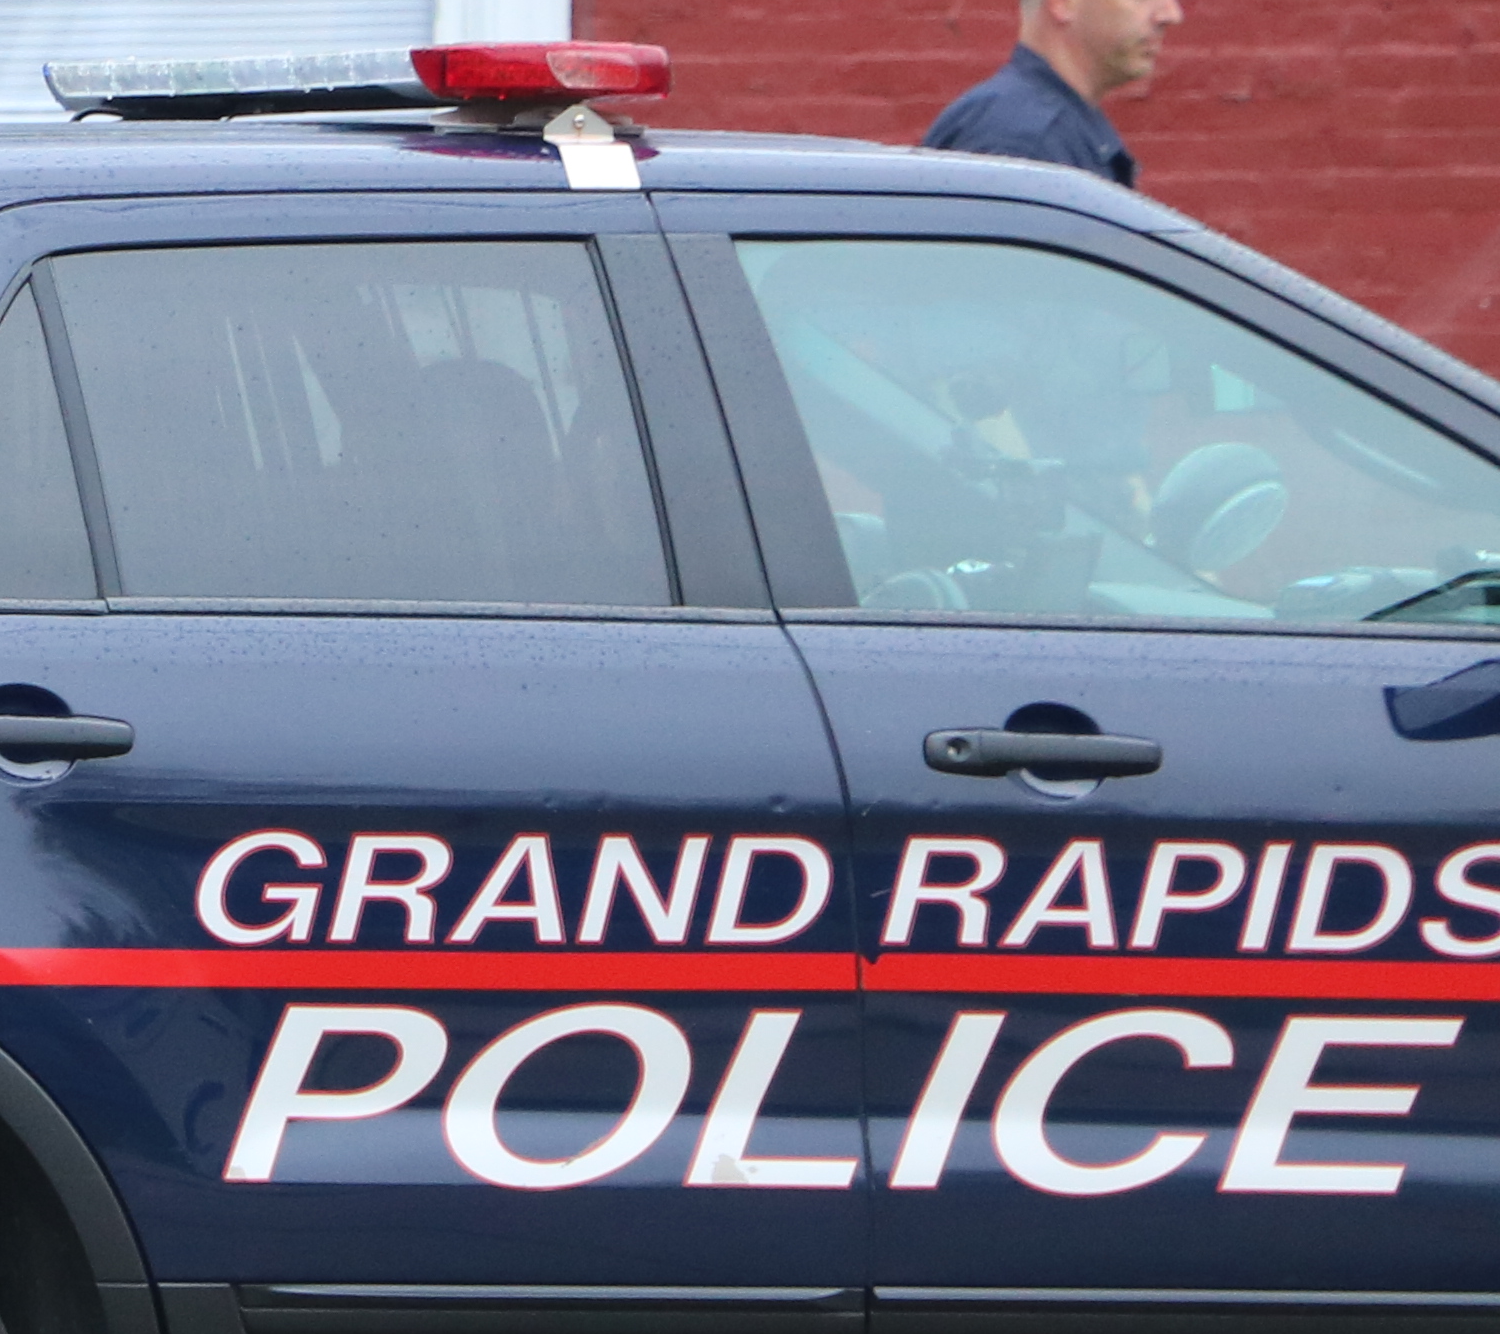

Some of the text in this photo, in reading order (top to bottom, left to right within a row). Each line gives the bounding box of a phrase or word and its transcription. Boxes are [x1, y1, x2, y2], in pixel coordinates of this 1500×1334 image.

[196, 829, 1500, 960] GRAND RAPIDS
[222, 1002, 1466, 1196] POLICE
